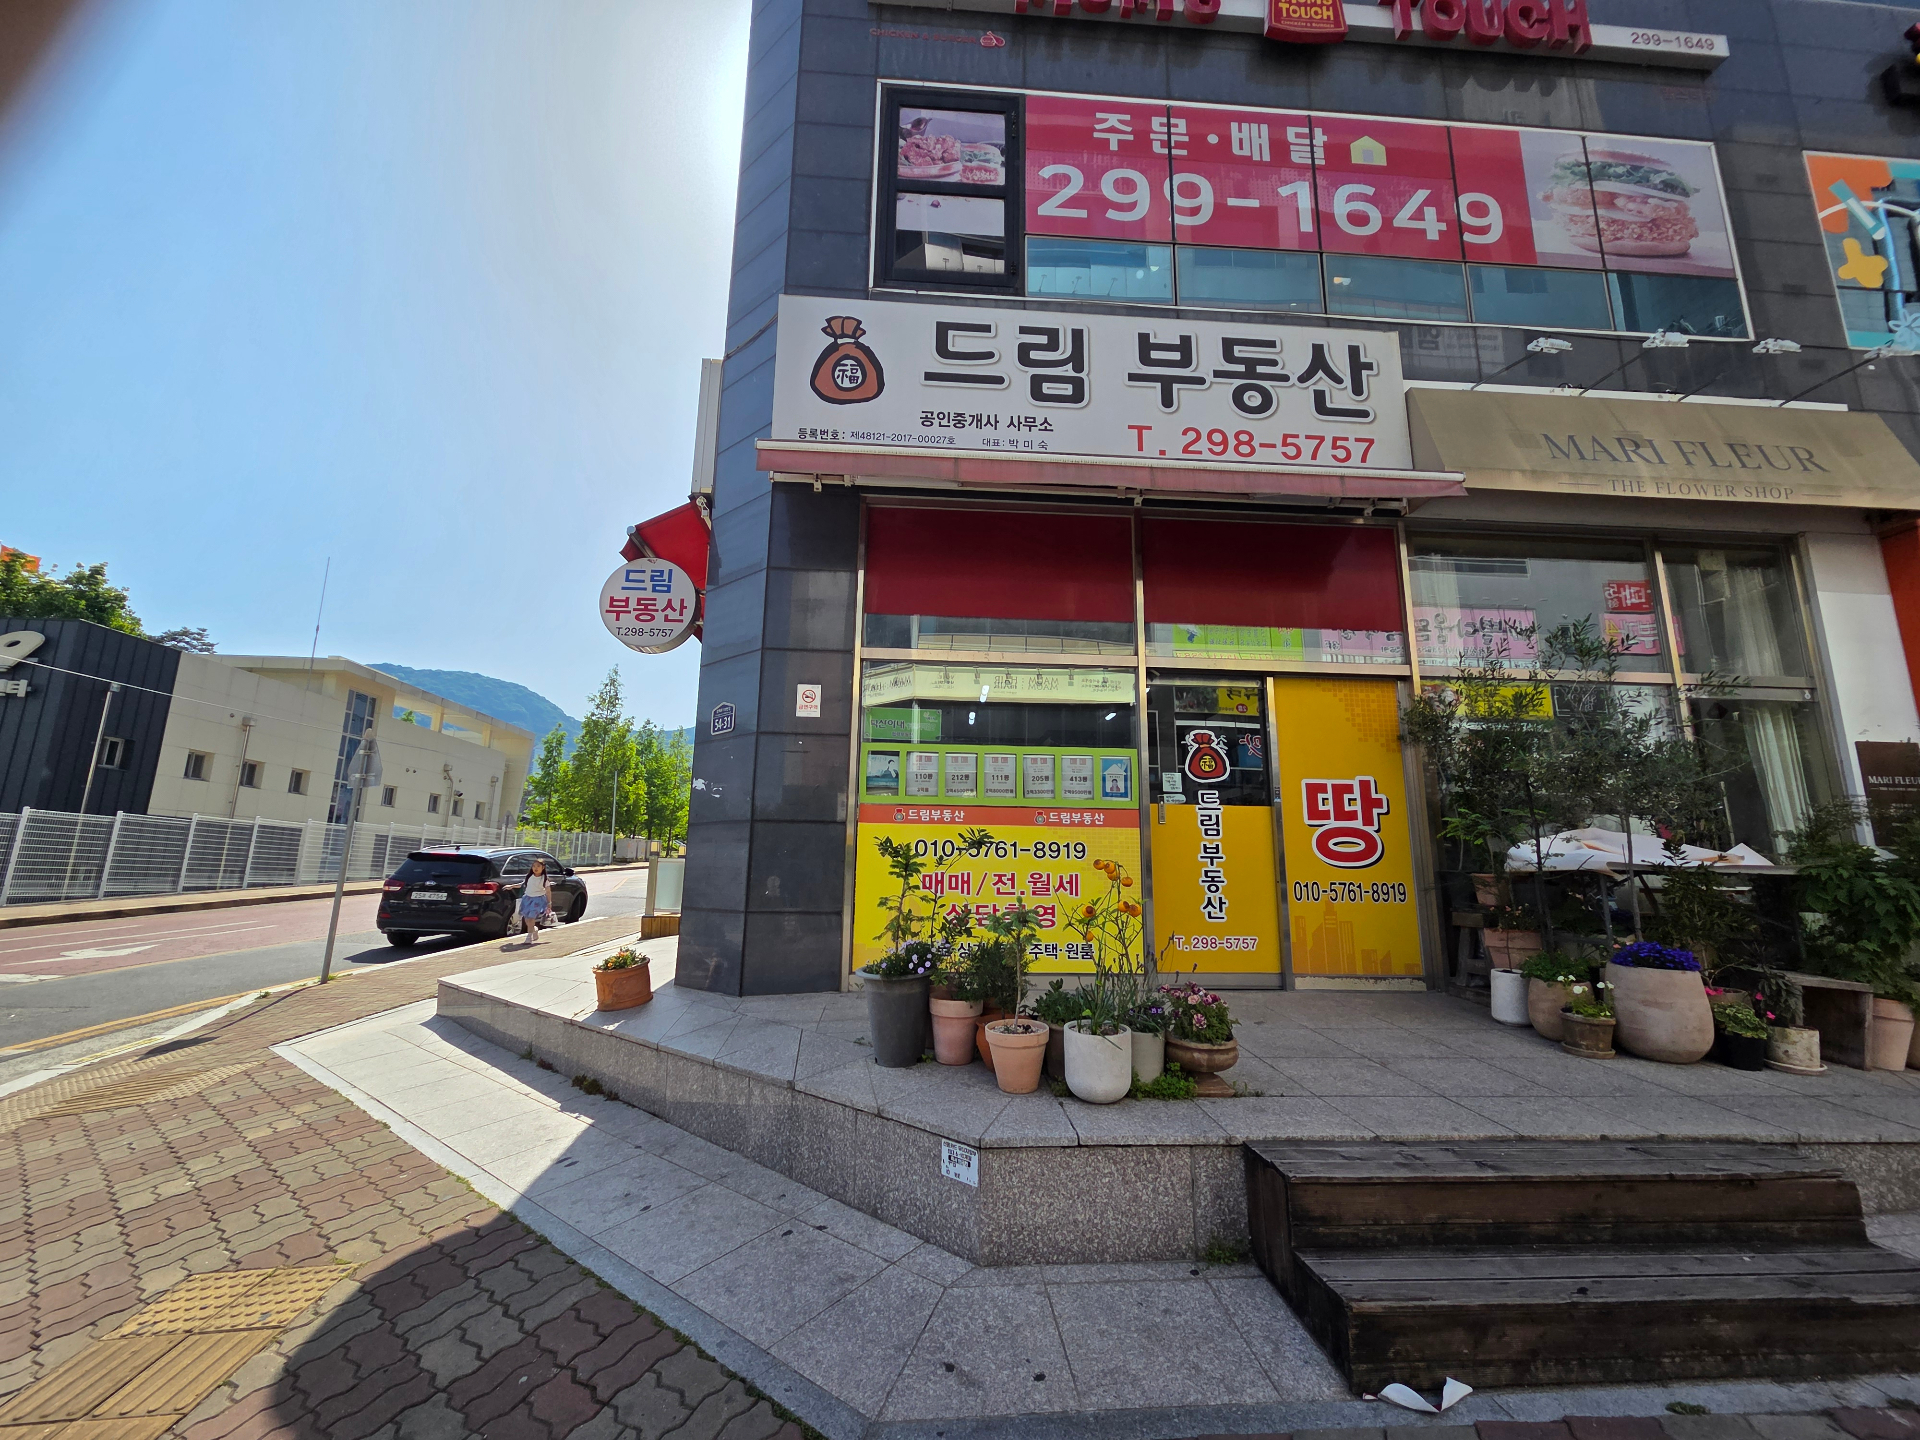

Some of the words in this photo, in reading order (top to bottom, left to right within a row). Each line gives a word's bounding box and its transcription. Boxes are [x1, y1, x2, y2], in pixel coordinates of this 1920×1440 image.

[1279, 2, 1334, 20] TOUCH
[1629, 31, 1715, 51] 299-1649
[1036, 164, 1504, 245] 299-1649
[922, 320, 1085, 403] 드림
[1127, 332, 1375, 419] 부동산
[919, 410, 1000, 431] 공인중개사
[1006, 415, 1055, 433] 사무소
[797, 427, 846, 441] 등록번호:
[849, 429, 957, 445] 제48121-2017-00027호
[1127, 424, 1167, 456] T.
[1181, 426, 1376, 464] 298-5757
[1541, 432, 1669, 466] MARI
[1671, 438, 1831, 473] FLEUR
[1607, 479, 1648, 493] THE
[1654, 480, 1740, 498] FLOWER
[1743, 485, 1795, 500] SHOP
[620, 568, 674, 594] 드림
[604, 595, 688, 623] 부동산
[615, 626, 674, 638] T.298-5757
[714, 716, 731, 731] 54-31
[1868, 775, 1893, 784] MARI
[907, 809, 965, 822] 드림부동산
[1048, 811, 1105, 825] 드림부동산
[1304, 776, 1386, 867] 땅
[1293, 880, 1407, 903] 010-5761-8919
[1192, 936, 1258, 950] 298-5757
